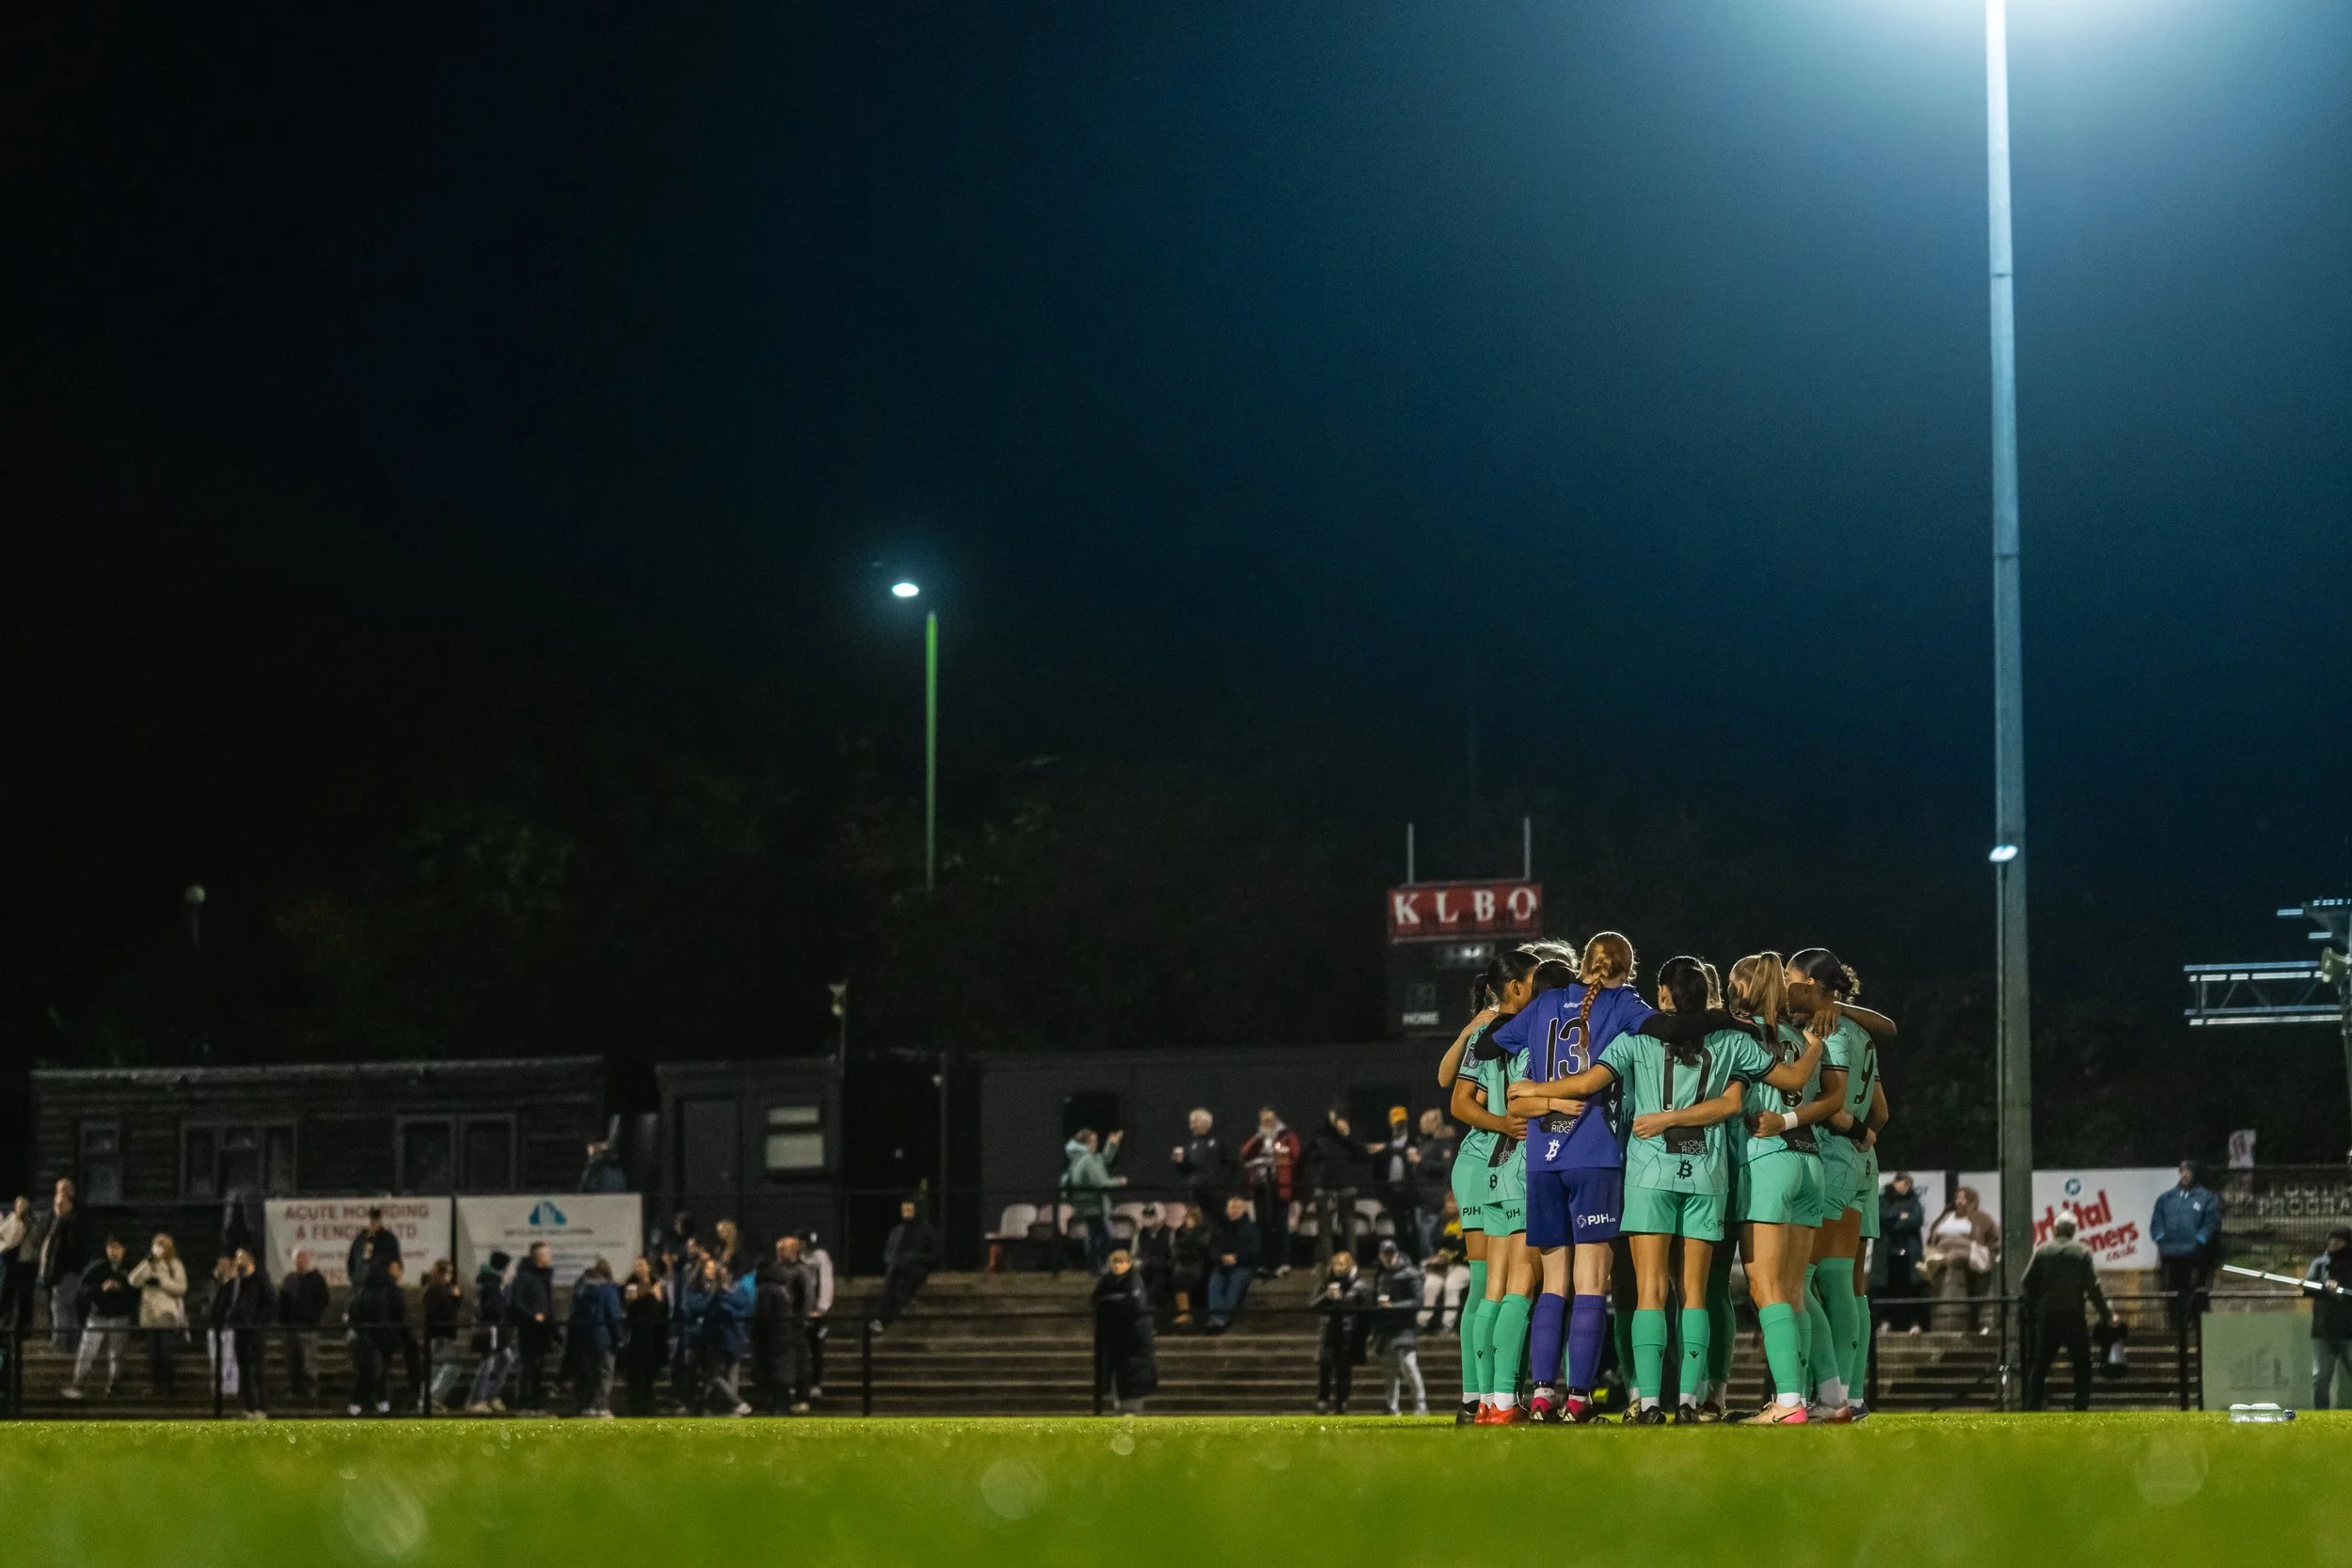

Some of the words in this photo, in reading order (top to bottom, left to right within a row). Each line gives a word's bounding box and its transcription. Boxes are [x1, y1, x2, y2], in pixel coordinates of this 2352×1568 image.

[1546, 1017, 1591, 1082] 13
[1551, 1125, 1574, 1135] RIDG
[1681, 1145, 1708, 1155] RIDGE
[285, 1205, 337, 1220] ACUTE
[342, 1203, 430, 1219] HORDING
[1462, 1206, 1482, 1216] PJH
[1587, 1213, 1609, 1226] PJH
[310, 1224, 361, 1240] FENC
